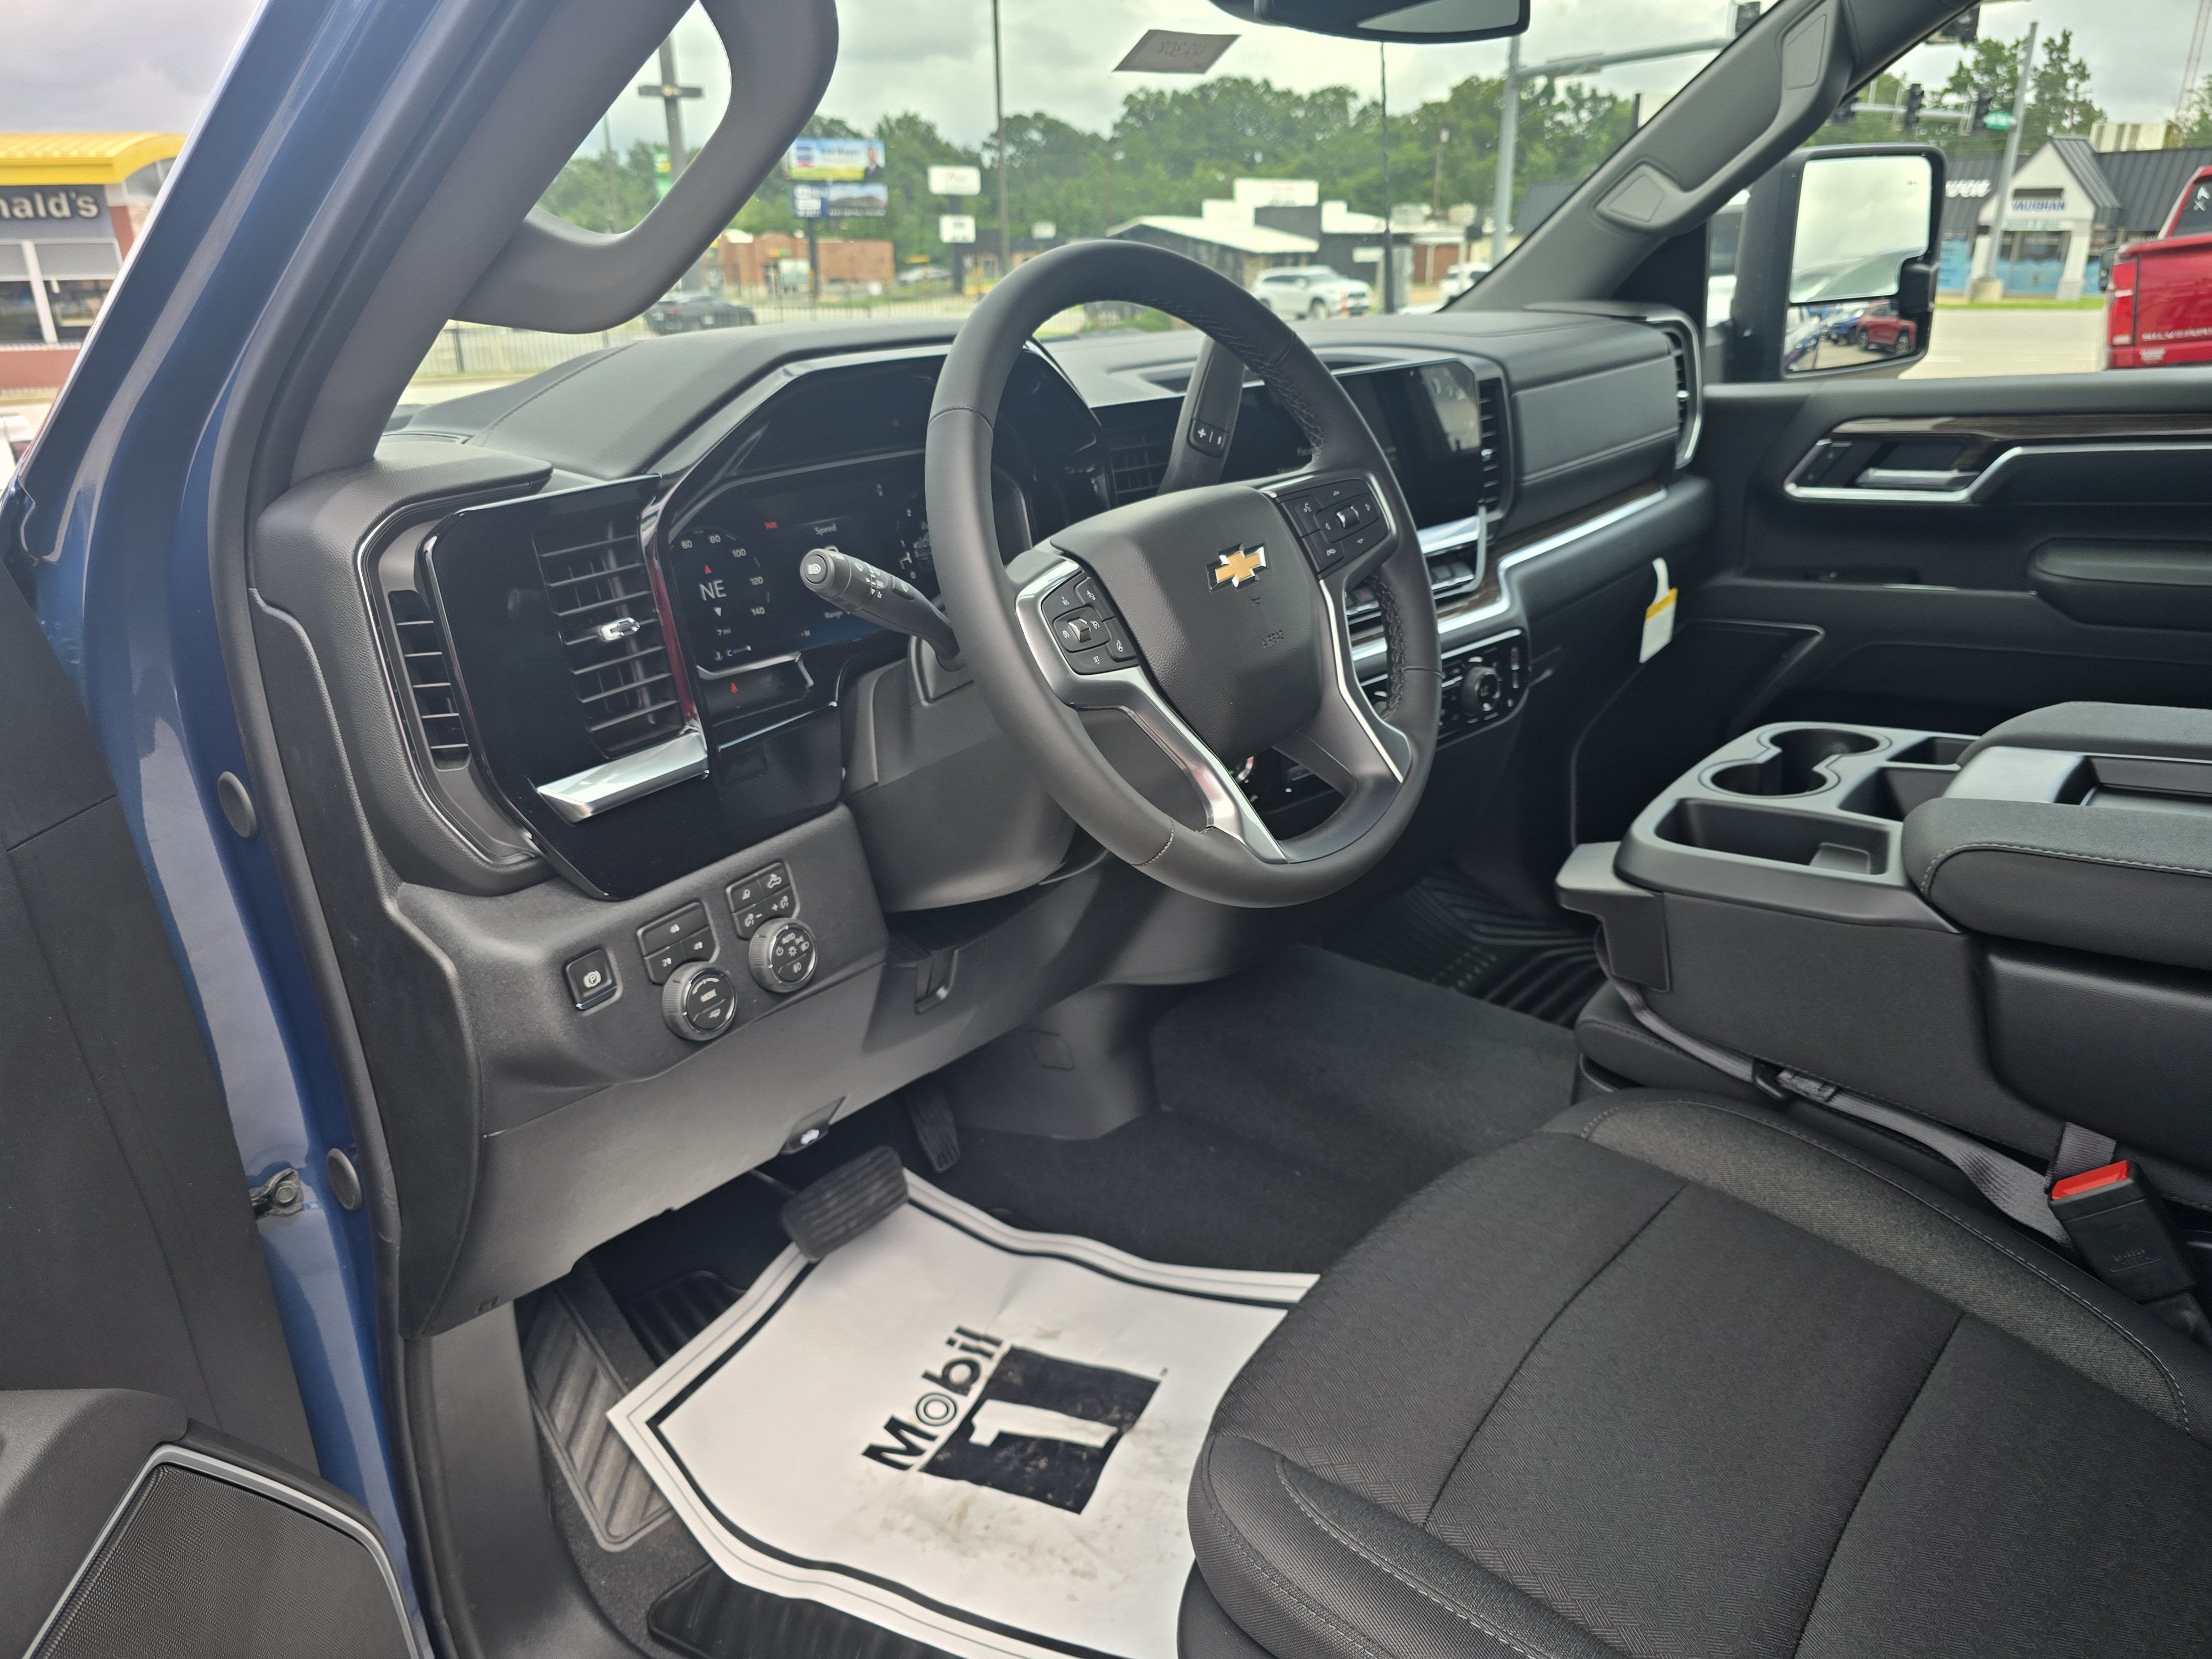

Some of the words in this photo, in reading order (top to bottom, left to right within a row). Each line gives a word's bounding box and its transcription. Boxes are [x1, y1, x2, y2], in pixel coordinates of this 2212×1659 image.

[815, 523, 837, 536] Speed
[732, 548, 747, 557] 100
[750, 576, 764, 585] 120
[698, 580, 727, 601] NE
[751, 606, 765, 615] 140
[860, 1326, 1003, 1472] Mobil
[968, 1399, 1119, 1449] 1
